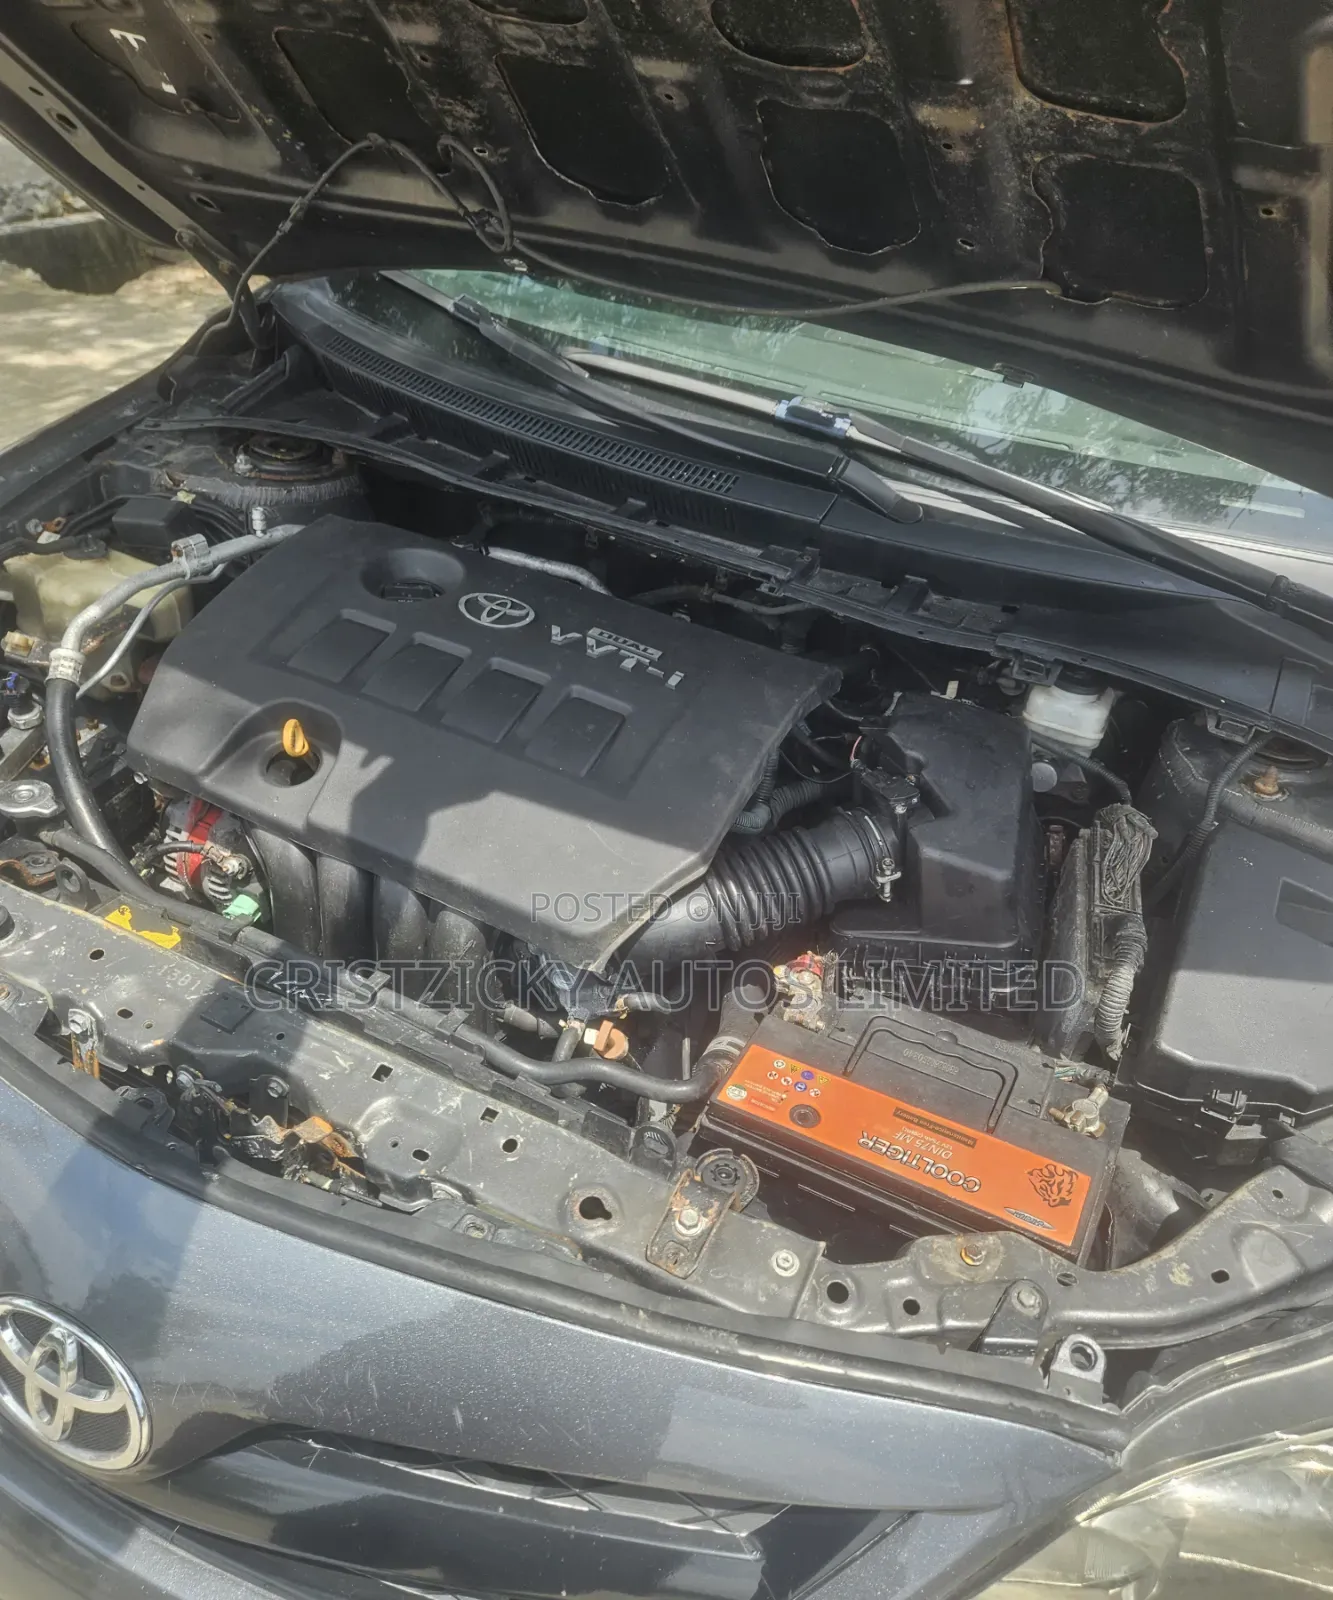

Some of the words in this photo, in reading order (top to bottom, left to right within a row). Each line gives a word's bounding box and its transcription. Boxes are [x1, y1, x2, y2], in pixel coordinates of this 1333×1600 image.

[594, 628, 658, 658] DUAL
[892, 1130, 915, 1144] MF
[915, 1139, 953, 1160] DIN75
[857, 1130, 982, 1193] COOLTIGER
